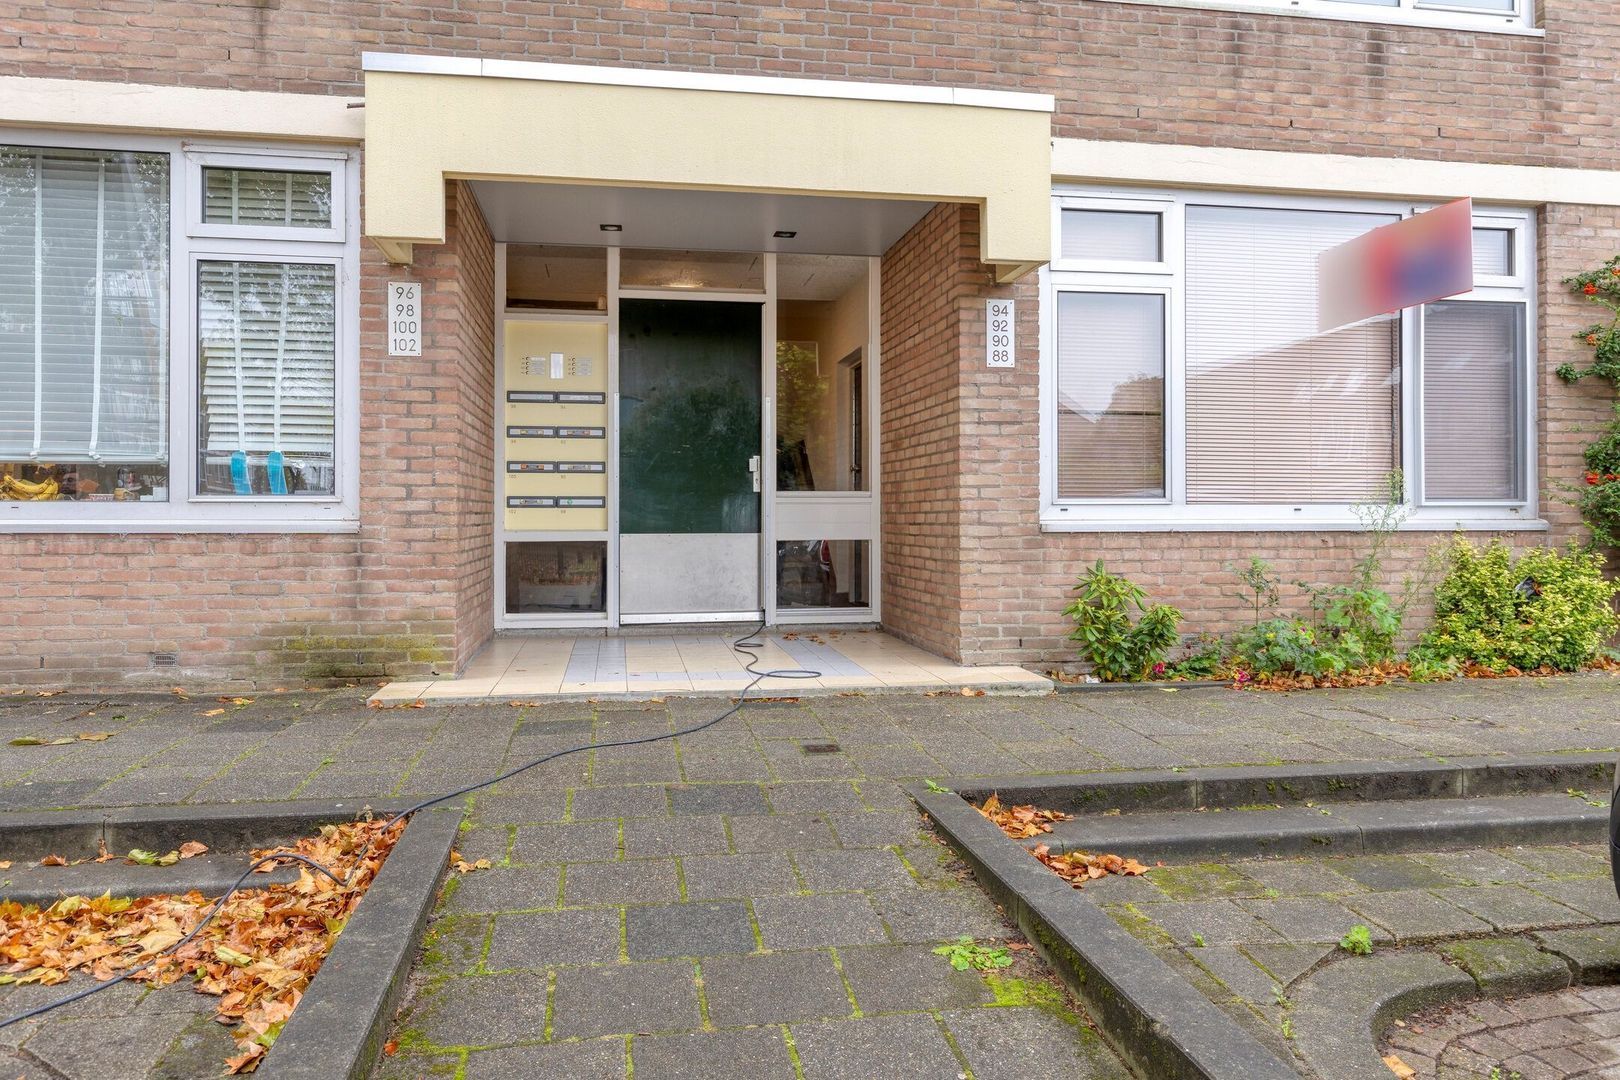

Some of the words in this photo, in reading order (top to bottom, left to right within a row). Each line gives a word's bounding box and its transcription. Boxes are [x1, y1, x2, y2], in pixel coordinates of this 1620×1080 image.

[396, 287, 414, 300] 96
[396, 304, 414, 317] 98
[992, 305, 1008, 317] 94
[393, 321, 417, 334] 100
[992, 320, 1008, 332] 92
[393, 338, 416, 351] 102
[992, 335, 1009, 347] 90
[992, 350, 1008, 362] 88
